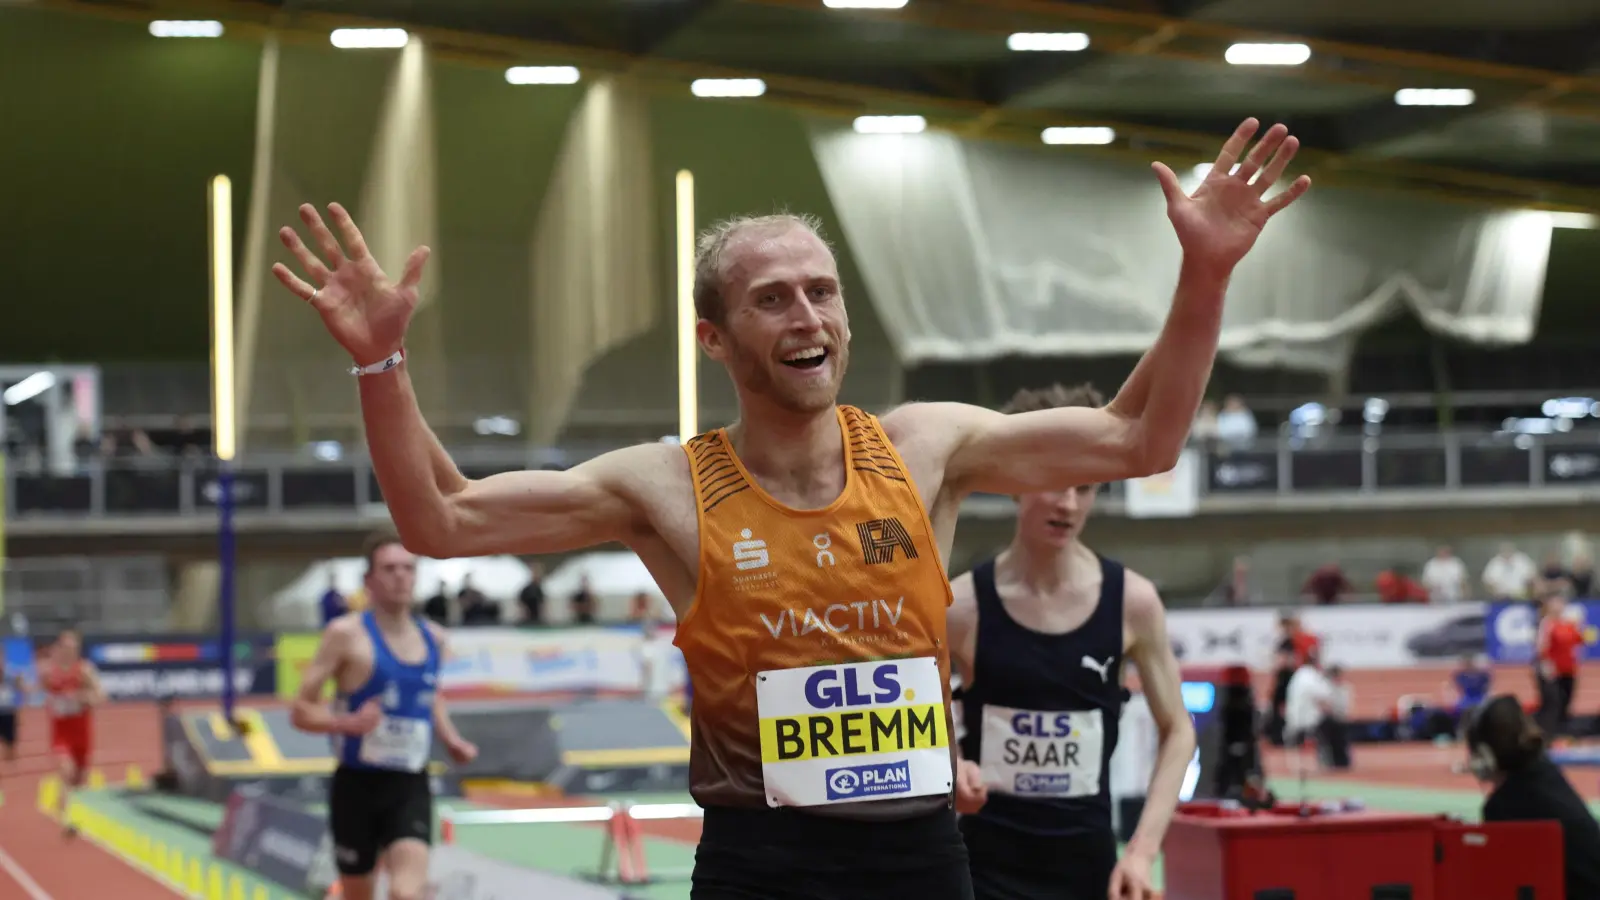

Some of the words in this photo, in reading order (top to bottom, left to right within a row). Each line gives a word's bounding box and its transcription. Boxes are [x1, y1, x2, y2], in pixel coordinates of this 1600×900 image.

[760, 596, 905, 640] VIACTIV
[775, 706, 937, 760] BREMM
[1003, 738, 1080, 767] SAAR
[862, 767, 907, 785] PLAN
[863, 783, 908, 792] INTERNATIONAL
